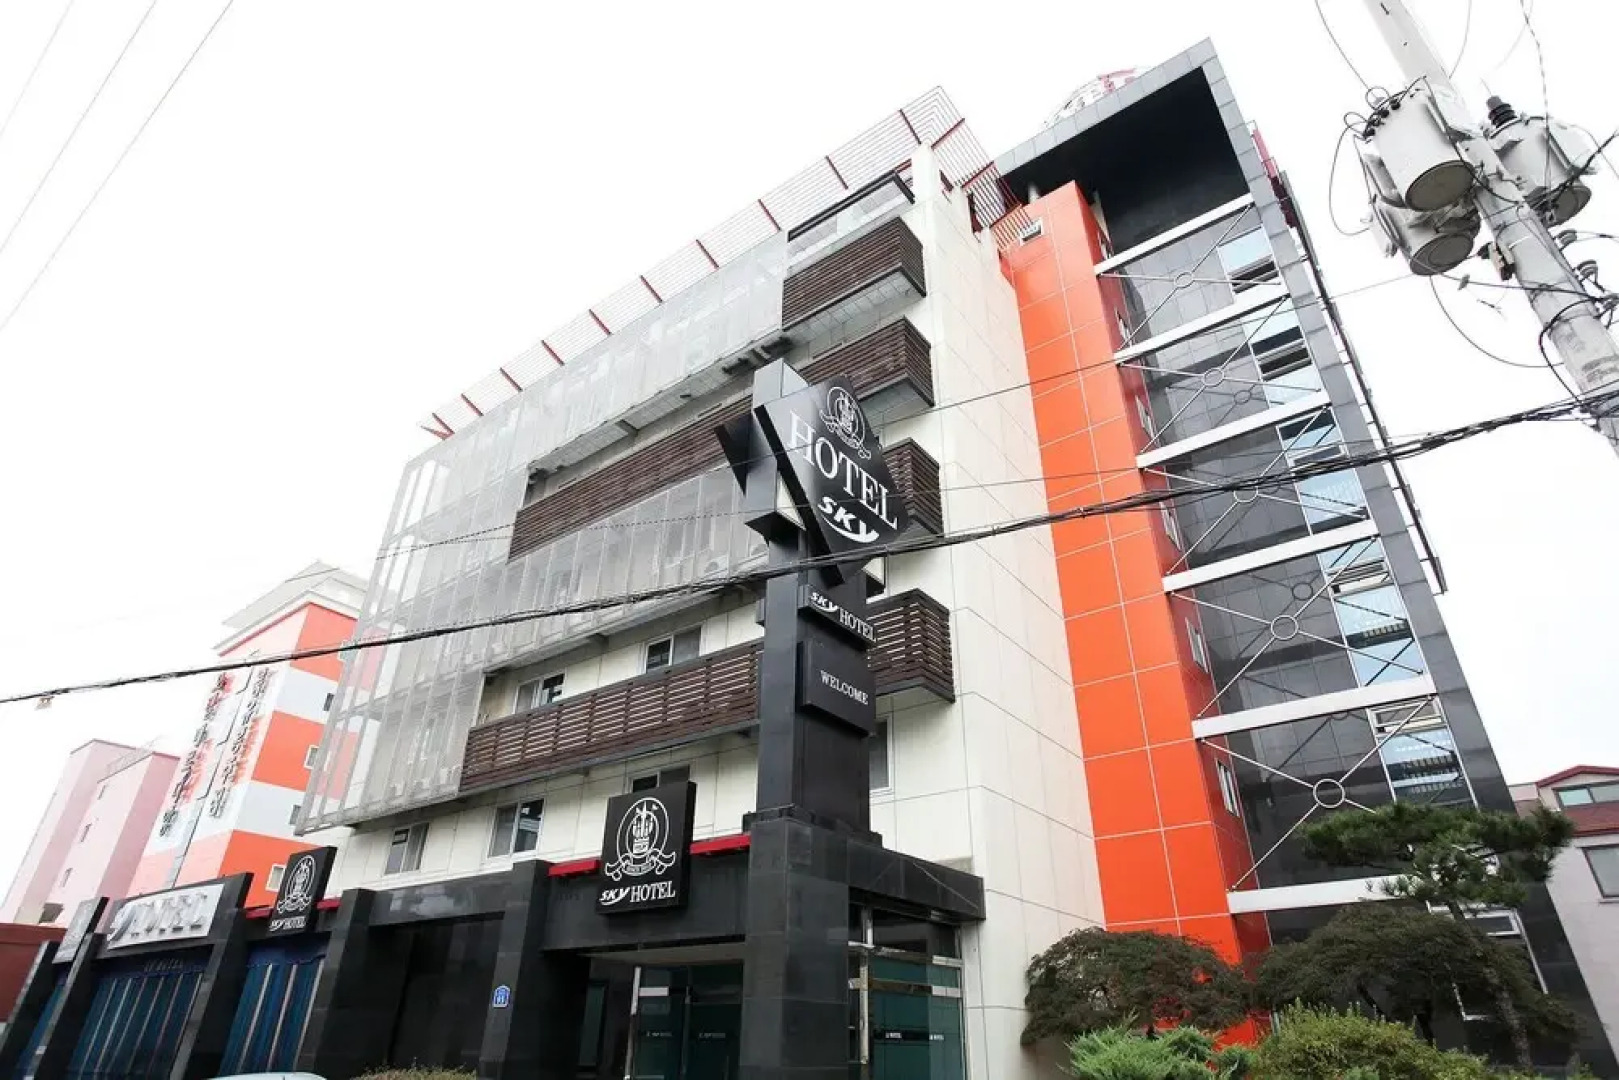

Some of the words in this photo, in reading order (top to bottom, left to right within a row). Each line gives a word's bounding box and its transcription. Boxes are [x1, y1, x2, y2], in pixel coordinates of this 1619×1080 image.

[786, 410, 898, 530] HOTEL
[817, 496, 880, 543] SKY
[810, 592, 839, 613] SKY
[840, 607, 876, 643] HOTEL
[820, 669, 869, 705] WELCOME
[599, 886, 630, 906] SKY
[630, 881, 676, 902] HOTEL
